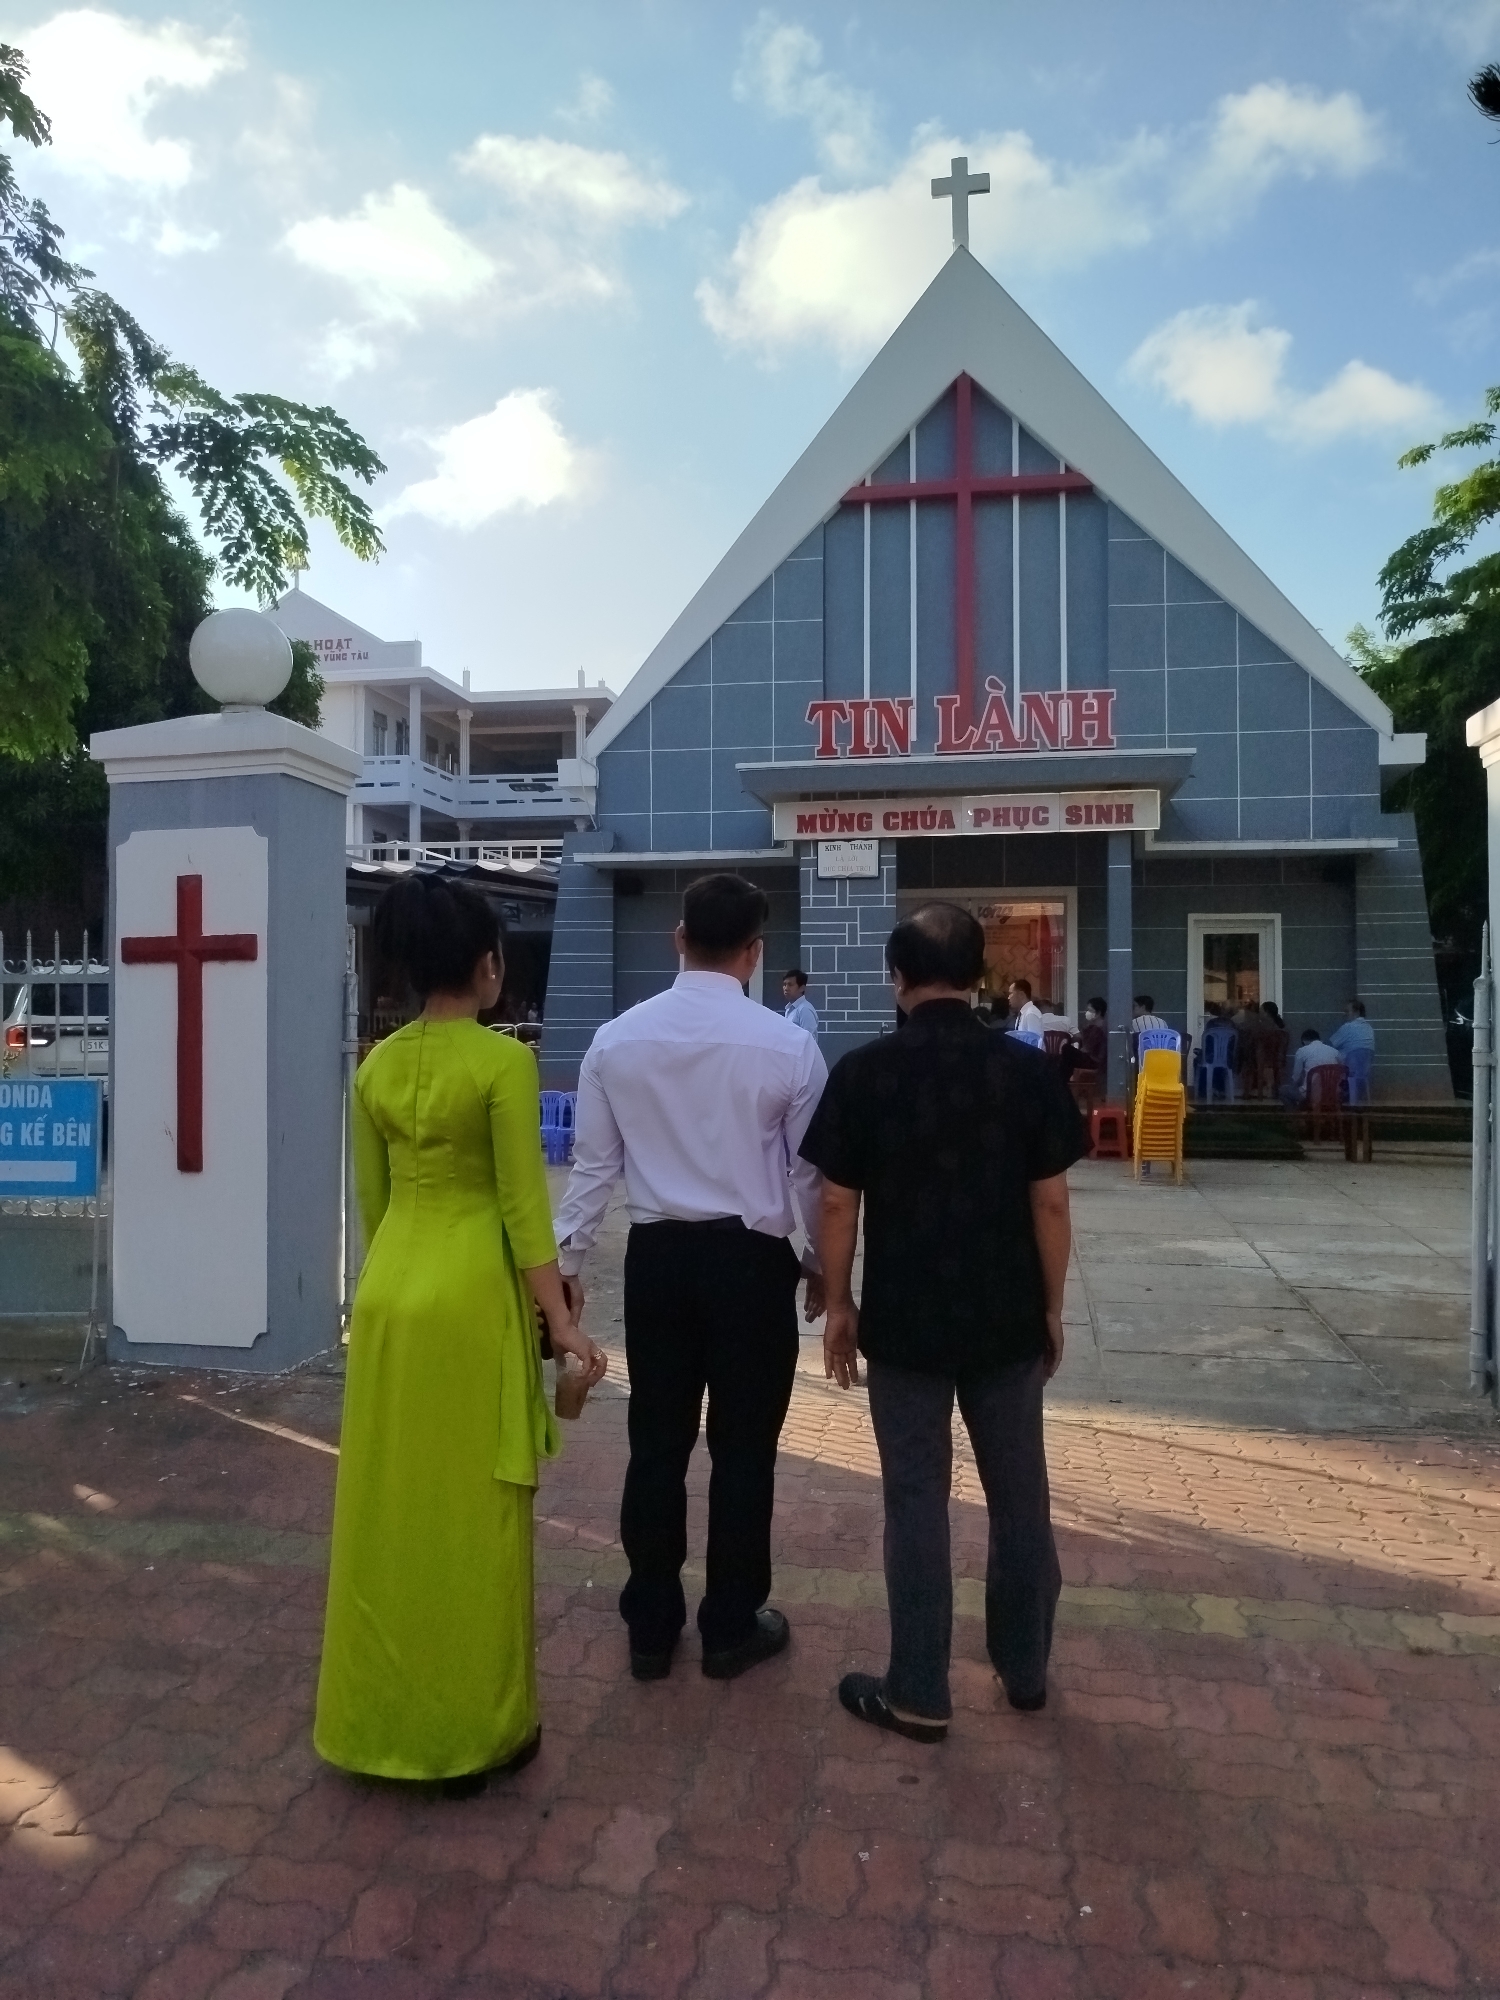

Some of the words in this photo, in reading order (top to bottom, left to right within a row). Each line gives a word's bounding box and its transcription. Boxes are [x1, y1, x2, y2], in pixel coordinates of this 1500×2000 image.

[314, 638, 352, 652] HOẠT
[351, 650, 369, 660] TÀU
[805, 697, 917, 758] TIN
[934, 676, 1117, 755] LÀNH
[796, 807, 873, 834] MỪNG
[882, 804, 956, 832] CHÚA
[972, 806, 1050, 831] PHỤC
[1065, 803, 1135, 826] SINH
[824, 844, 842, 852] KINH
[850, 841, 873, 851] THÁNH
[20, 1113, 48, 1146] KẾ
[52, 1117, 91, 1147] BÊN
